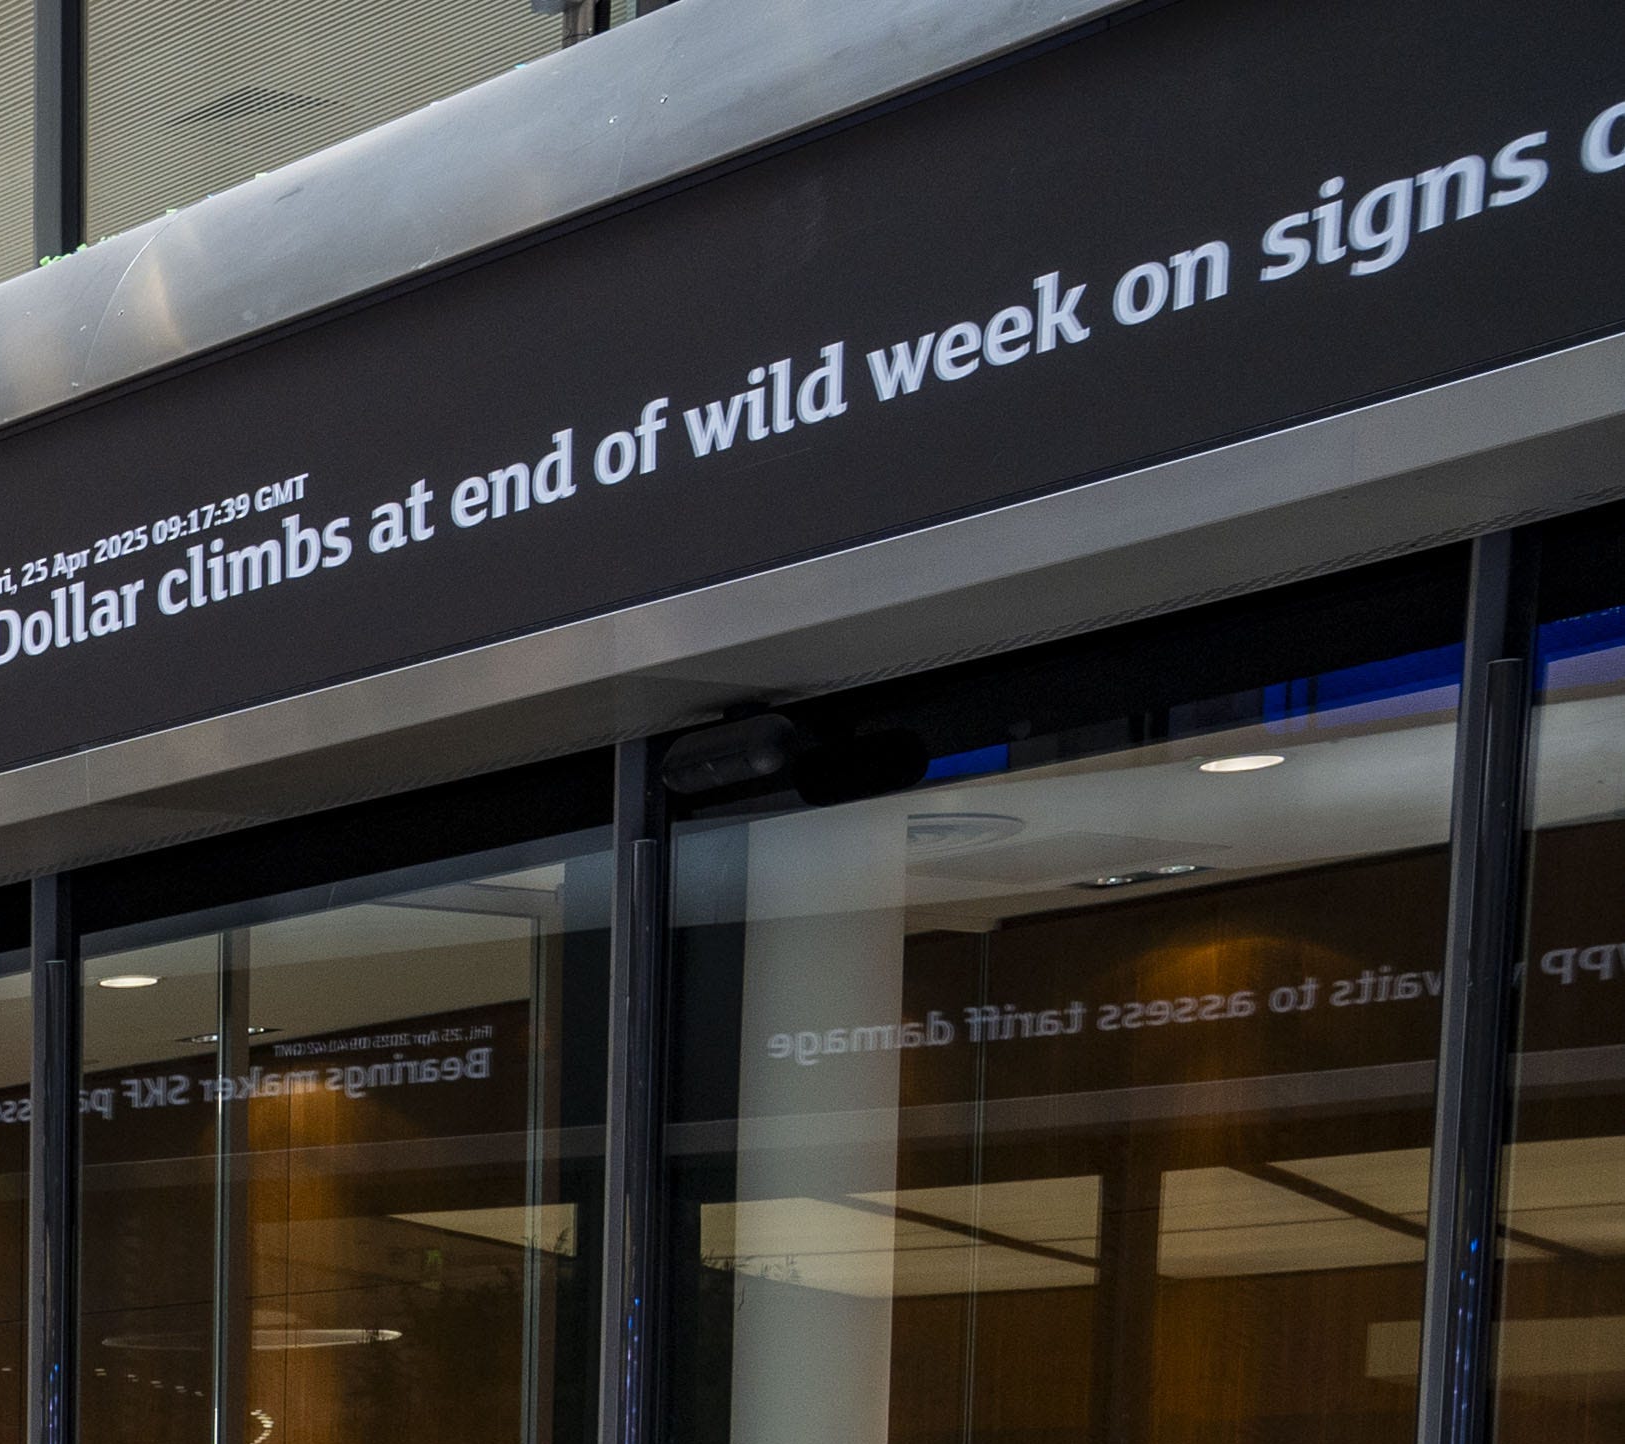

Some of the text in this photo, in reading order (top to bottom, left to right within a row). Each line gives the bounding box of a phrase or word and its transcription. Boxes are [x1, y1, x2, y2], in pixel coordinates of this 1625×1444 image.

[158, 514, 352, 615] climbs
[369, 479, 434, 553] at
[451, 428, 577, 528] end
[594, 397, 668, 485] of
[683, 341, 848, 457] wild
[866, 271, 1090, 401] week
[1113, 241, 1229, 325] on
[1260, 131, 1548, 281] signs
[21, 558, 48, 587] 25
[51, 549, 90, 579] Apr
[94, 525, 148, 564] 2025
[152, 493, 250, 544] 09:17:39
[254, 473, 309, 512] GMT
